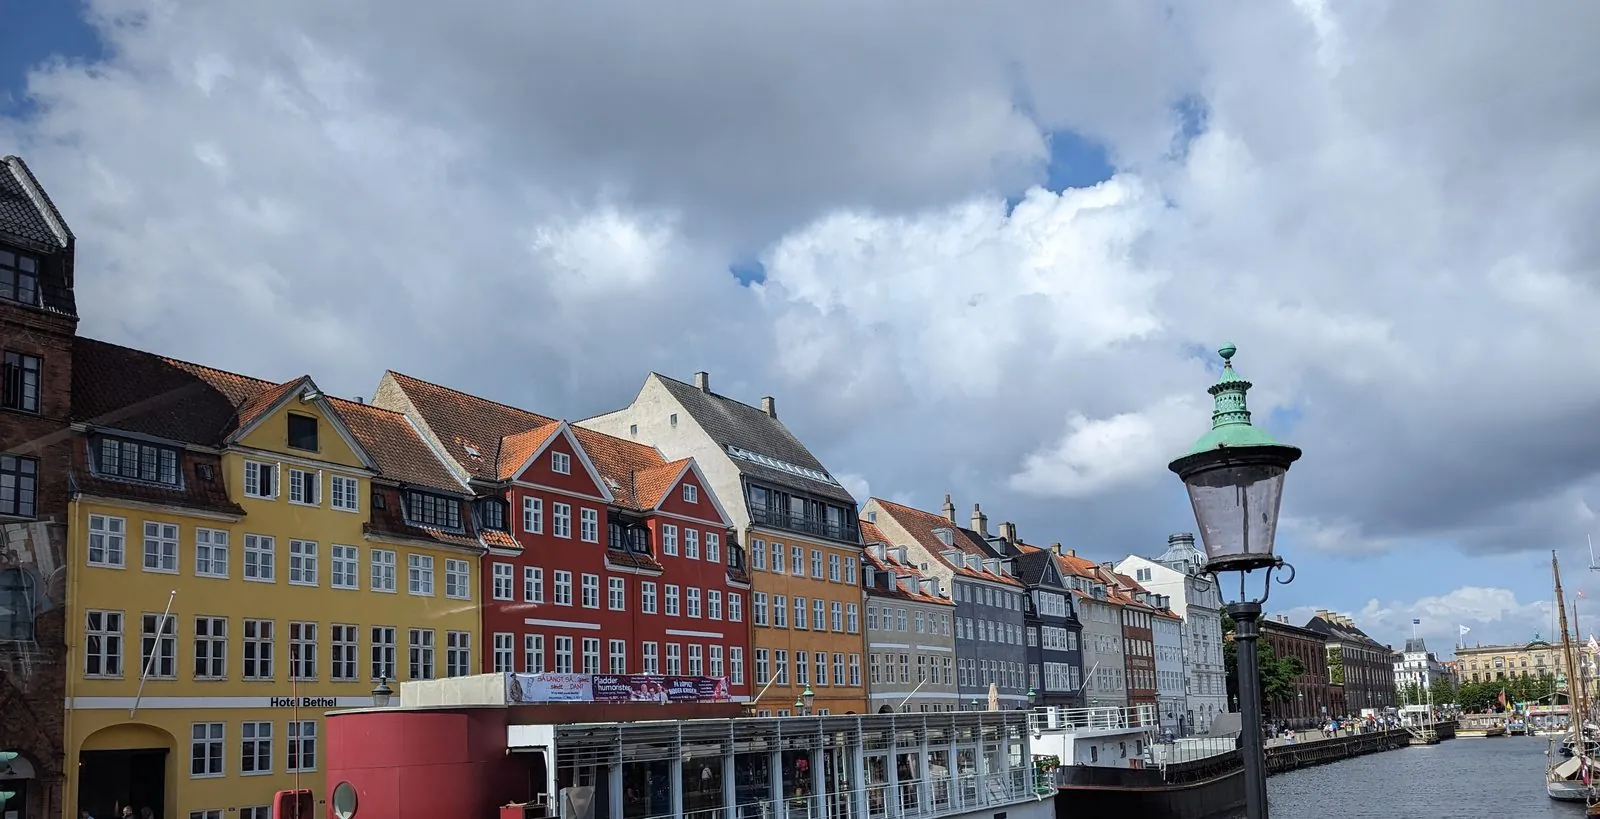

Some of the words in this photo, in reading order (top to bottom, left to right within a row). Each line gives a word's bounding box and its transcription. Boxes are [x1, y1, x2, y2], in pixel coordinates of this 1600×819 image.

[593, 676, 618, 684] Pladder
[598, 682, 631, 691] humorister
[270, 697, 300, 707] Hotel
[303, 697, 337, 707] Bethel
